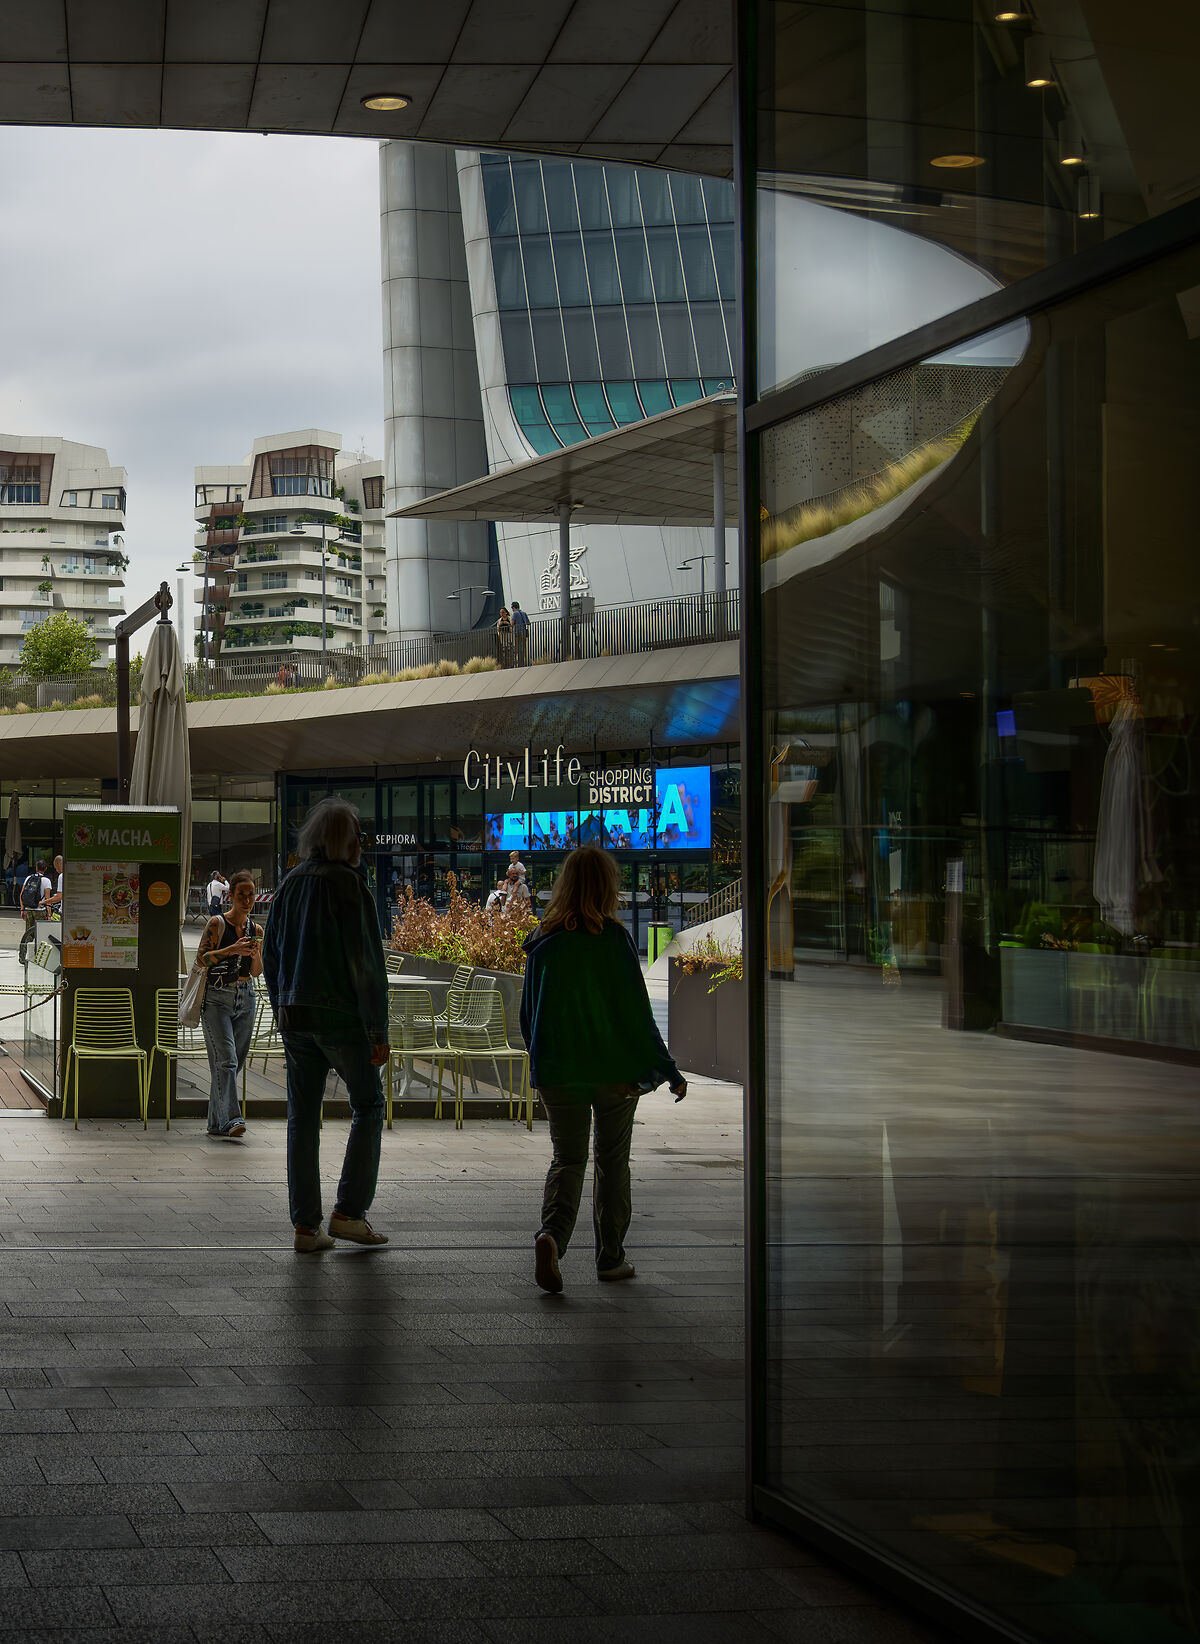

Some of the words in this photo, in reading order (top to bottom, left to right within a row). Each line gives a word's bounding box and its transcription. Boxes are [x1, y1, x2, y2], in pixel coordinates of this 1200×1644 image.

[463, 743, 582, 802] CityLife
[589, 767, 653, 787] SHOPPING
[588, 784, 653, 804] DISTRICT
[97, 828, 153, 846] MACHA
[375, 833, 417, 845] SEPHORA
